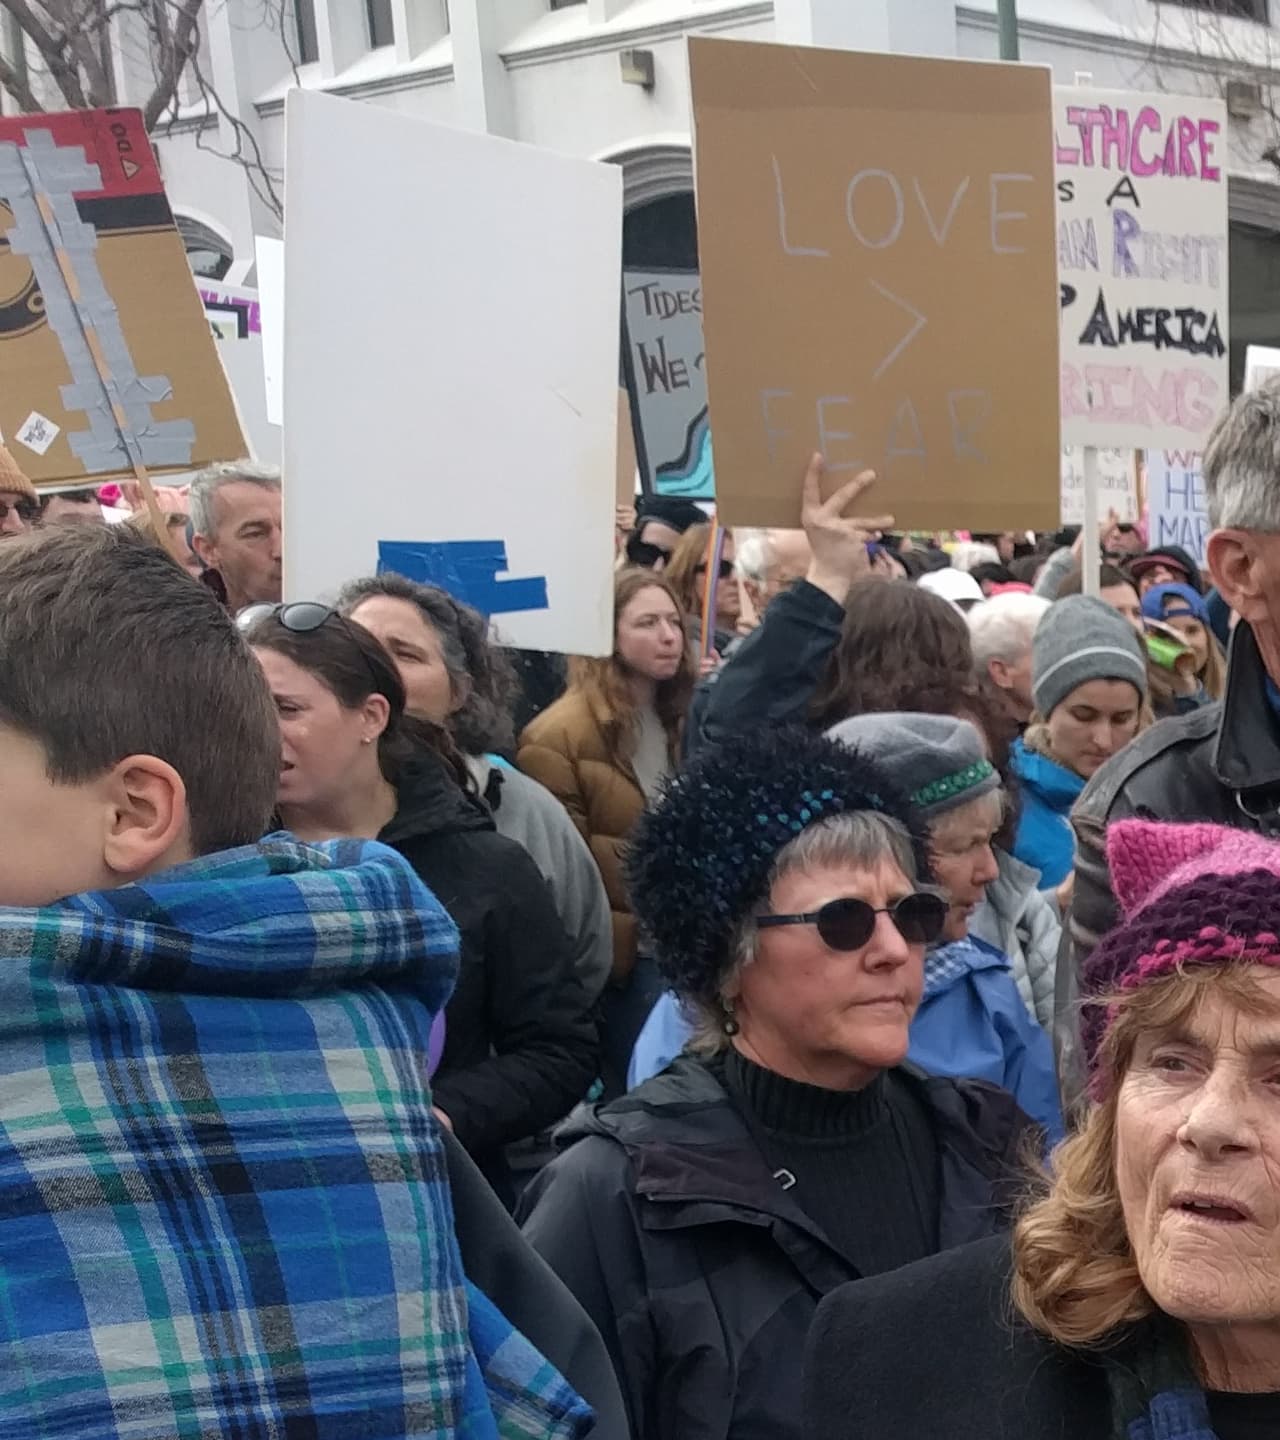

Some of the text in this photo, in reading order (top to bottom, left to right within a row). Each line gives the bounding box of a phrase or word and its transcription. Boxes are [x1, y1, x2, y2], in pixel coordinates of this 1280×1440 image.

[771, 152, 1034, 257] LOVE
[1105, 175, 1141, 208] A
[627, 281, 703, 320] TIDES
[1078, 284, 1227, 358] AMERICA
[759, 388, 990, 474] FEAR
